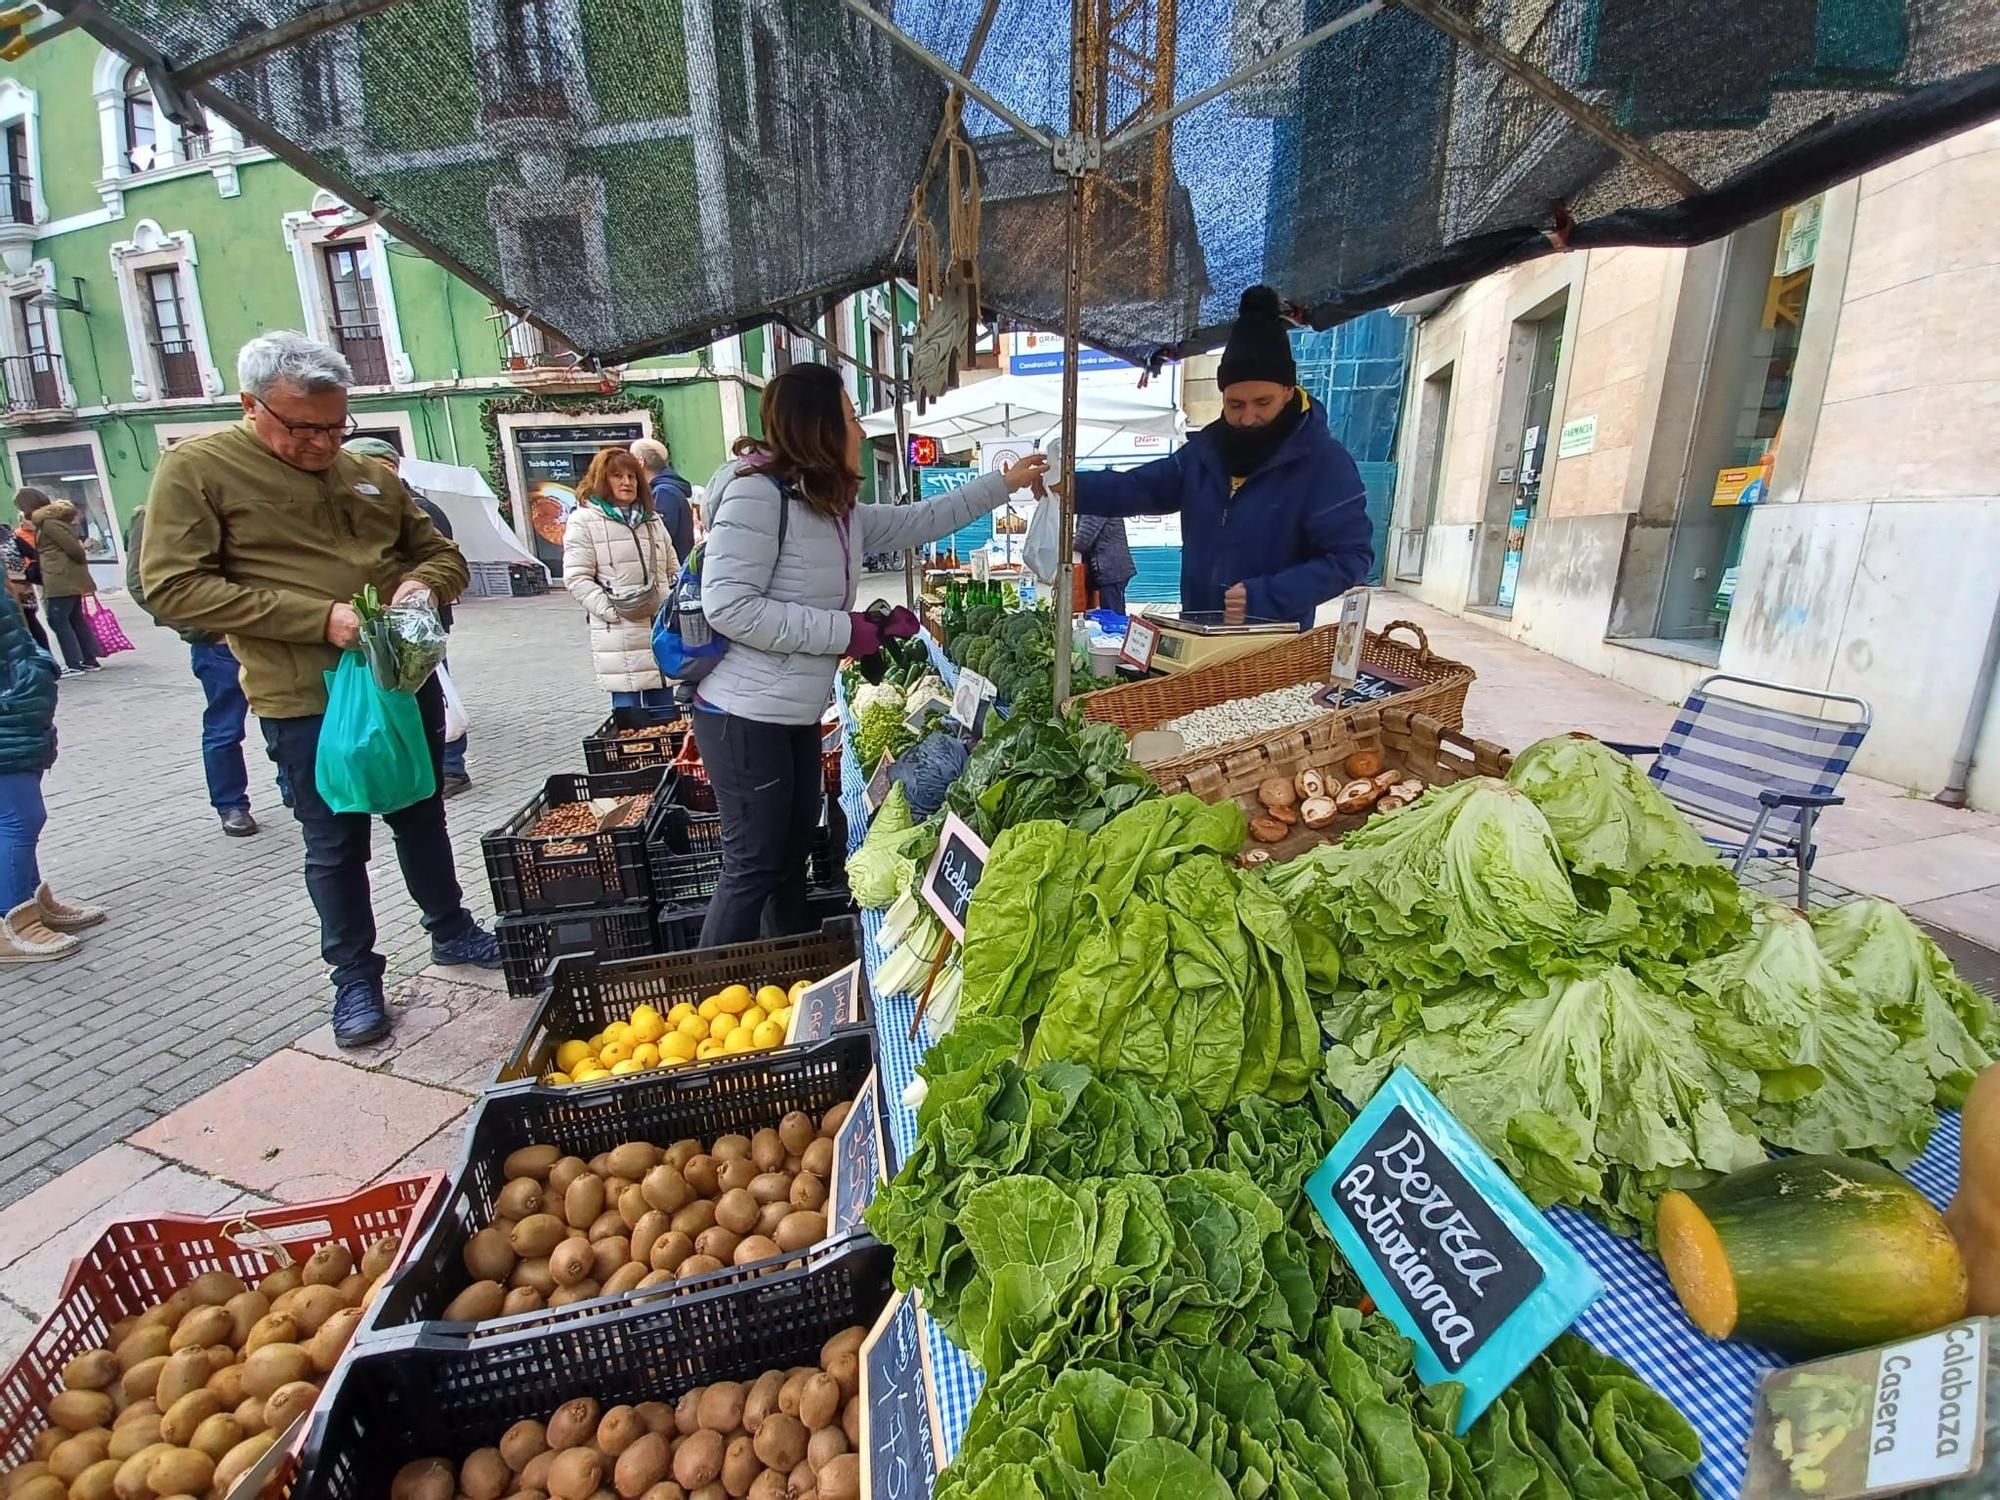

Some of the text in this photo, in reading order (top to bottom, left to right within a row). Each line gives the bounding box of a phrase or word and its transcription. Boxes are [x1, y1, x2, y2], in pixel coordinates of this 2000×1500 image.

[1019, 360, 1057, 369] Construcción
[1340, 1164, 1475, 1363] Asturiana
[1375, 1129, 1502, 1298] Berza
[900, 1285, 917, 1360] KIWI
[1873, 1355, 1911, 1455] Casera
[1936, 1326, 1974, 1458] Calabaza
